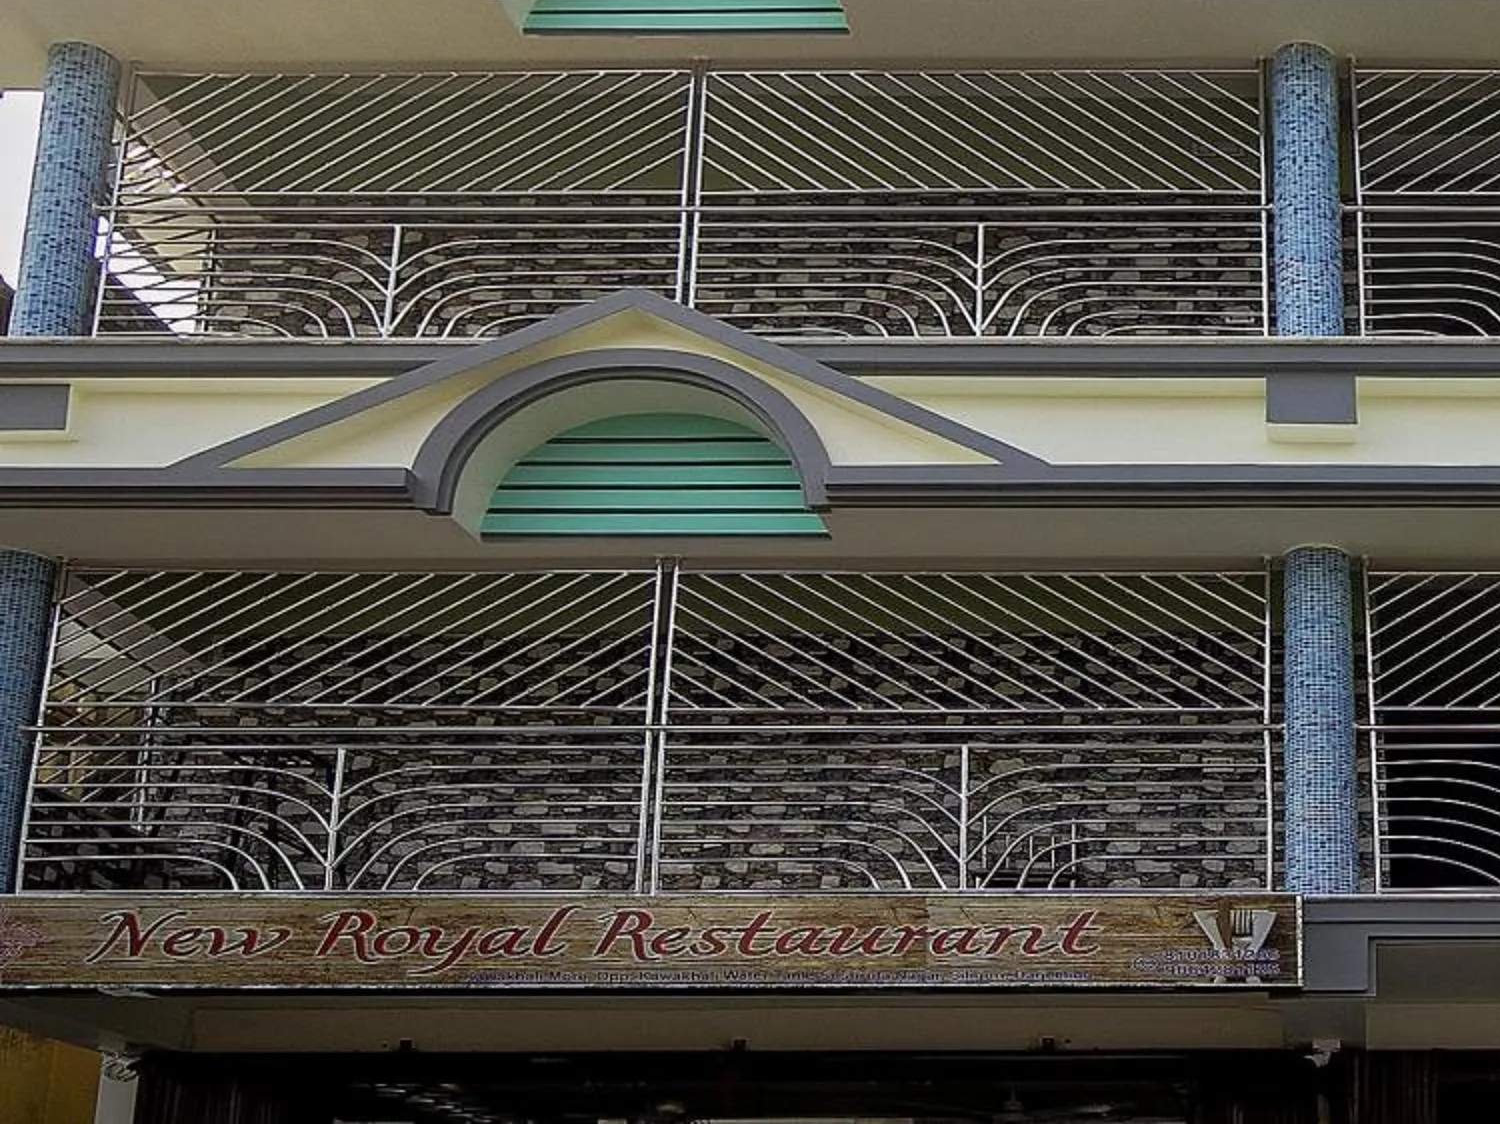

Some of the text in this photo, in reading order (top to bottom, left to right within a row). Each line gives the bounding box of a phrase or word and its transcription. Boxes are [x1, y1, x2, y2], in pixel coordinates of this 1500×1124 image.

[85, 903, 1104, 975] New Royal Restaurant
